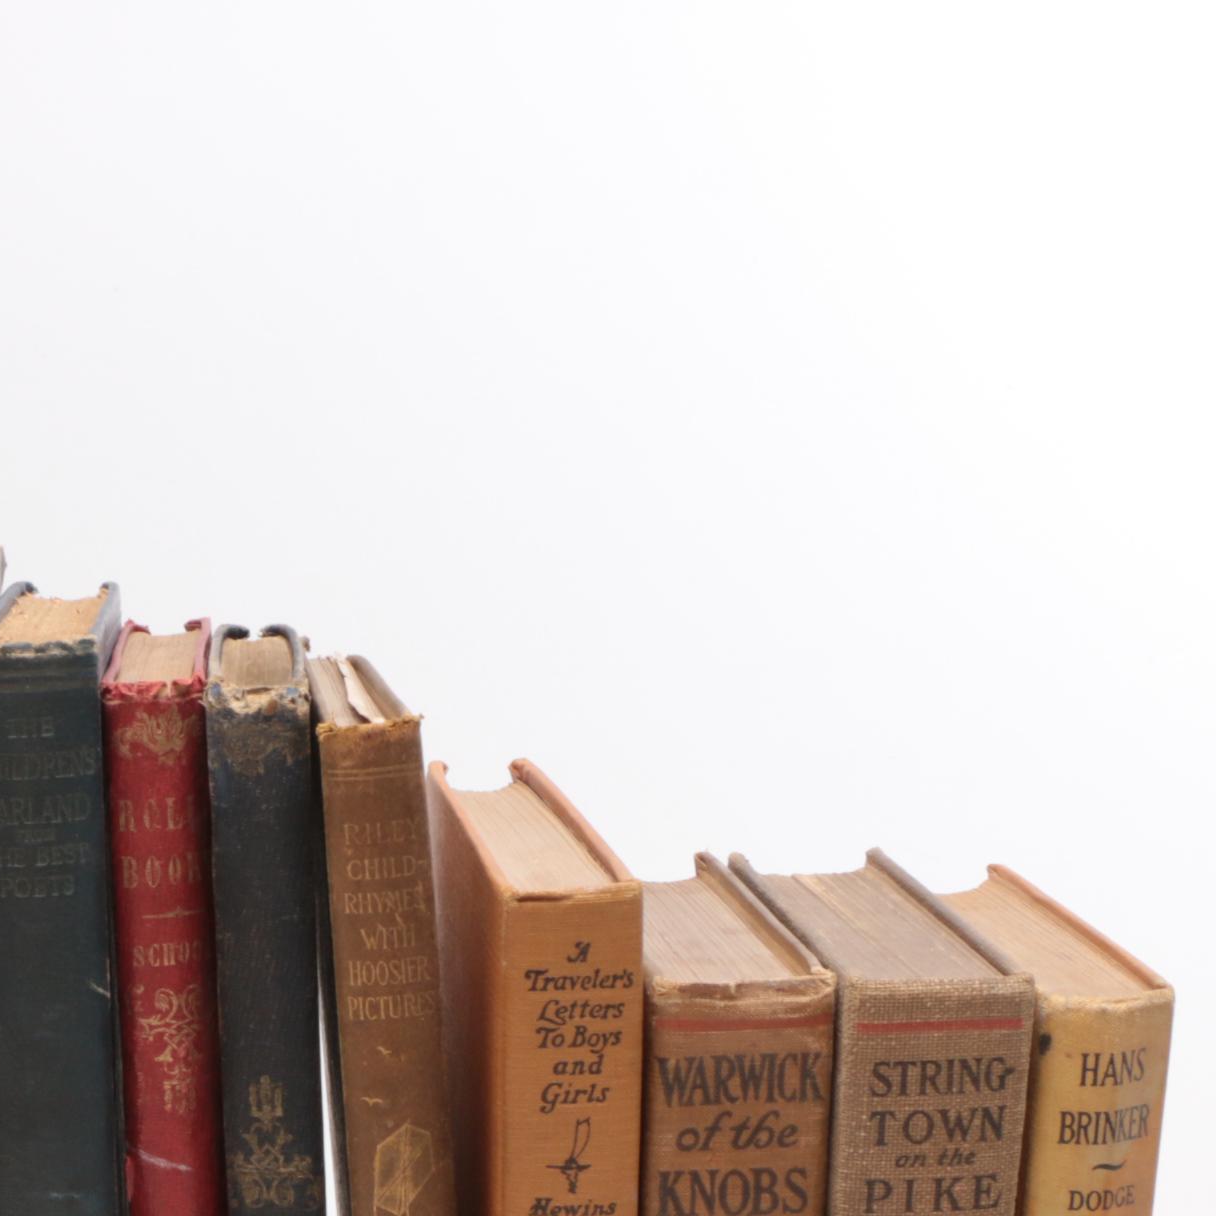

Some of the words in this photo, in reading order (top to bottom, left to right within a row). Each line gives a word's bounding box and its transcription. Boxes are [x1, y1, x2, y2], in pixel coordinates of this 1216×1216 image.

[344, 818, 420, 846] RILEY
[344, 883, 426, 915] RHYMES
[360, 924, 416, 950] WITH
[567, 940, 591, 964] A
[347, 956, 432, 986] HOOSIER
[525, 968, 635, 992] Traveler's
[537, 999, 624, 1026] Letters
[535, 1026, 564, 1049] To
[569, 1025, 622, 1053] Boys
[552, 1054, 603, 1076] and
[656, 1050, 824, 1108] WARWICK
[870, 1056, 1016, 1098] STRING
[1079, 1047, 1146, 1088] HANS
[541, 1083, 610, 1114] Girls
[676, 1111, 732, 1151] of
[730, 1109, 799, 1150] the
[869, 1104, 1008, 1147] TOWN
[1057, 1103, 1150, 1146] BRINKER
[895, 1152, 926, 1168] on
[938, 1148, 977, 1167] the
[528, 1197, 617, 1216] Hewins
[863, 1173, 1002, 1215] PIKE
[1067, 1185, 1136, 1212] DODGE
